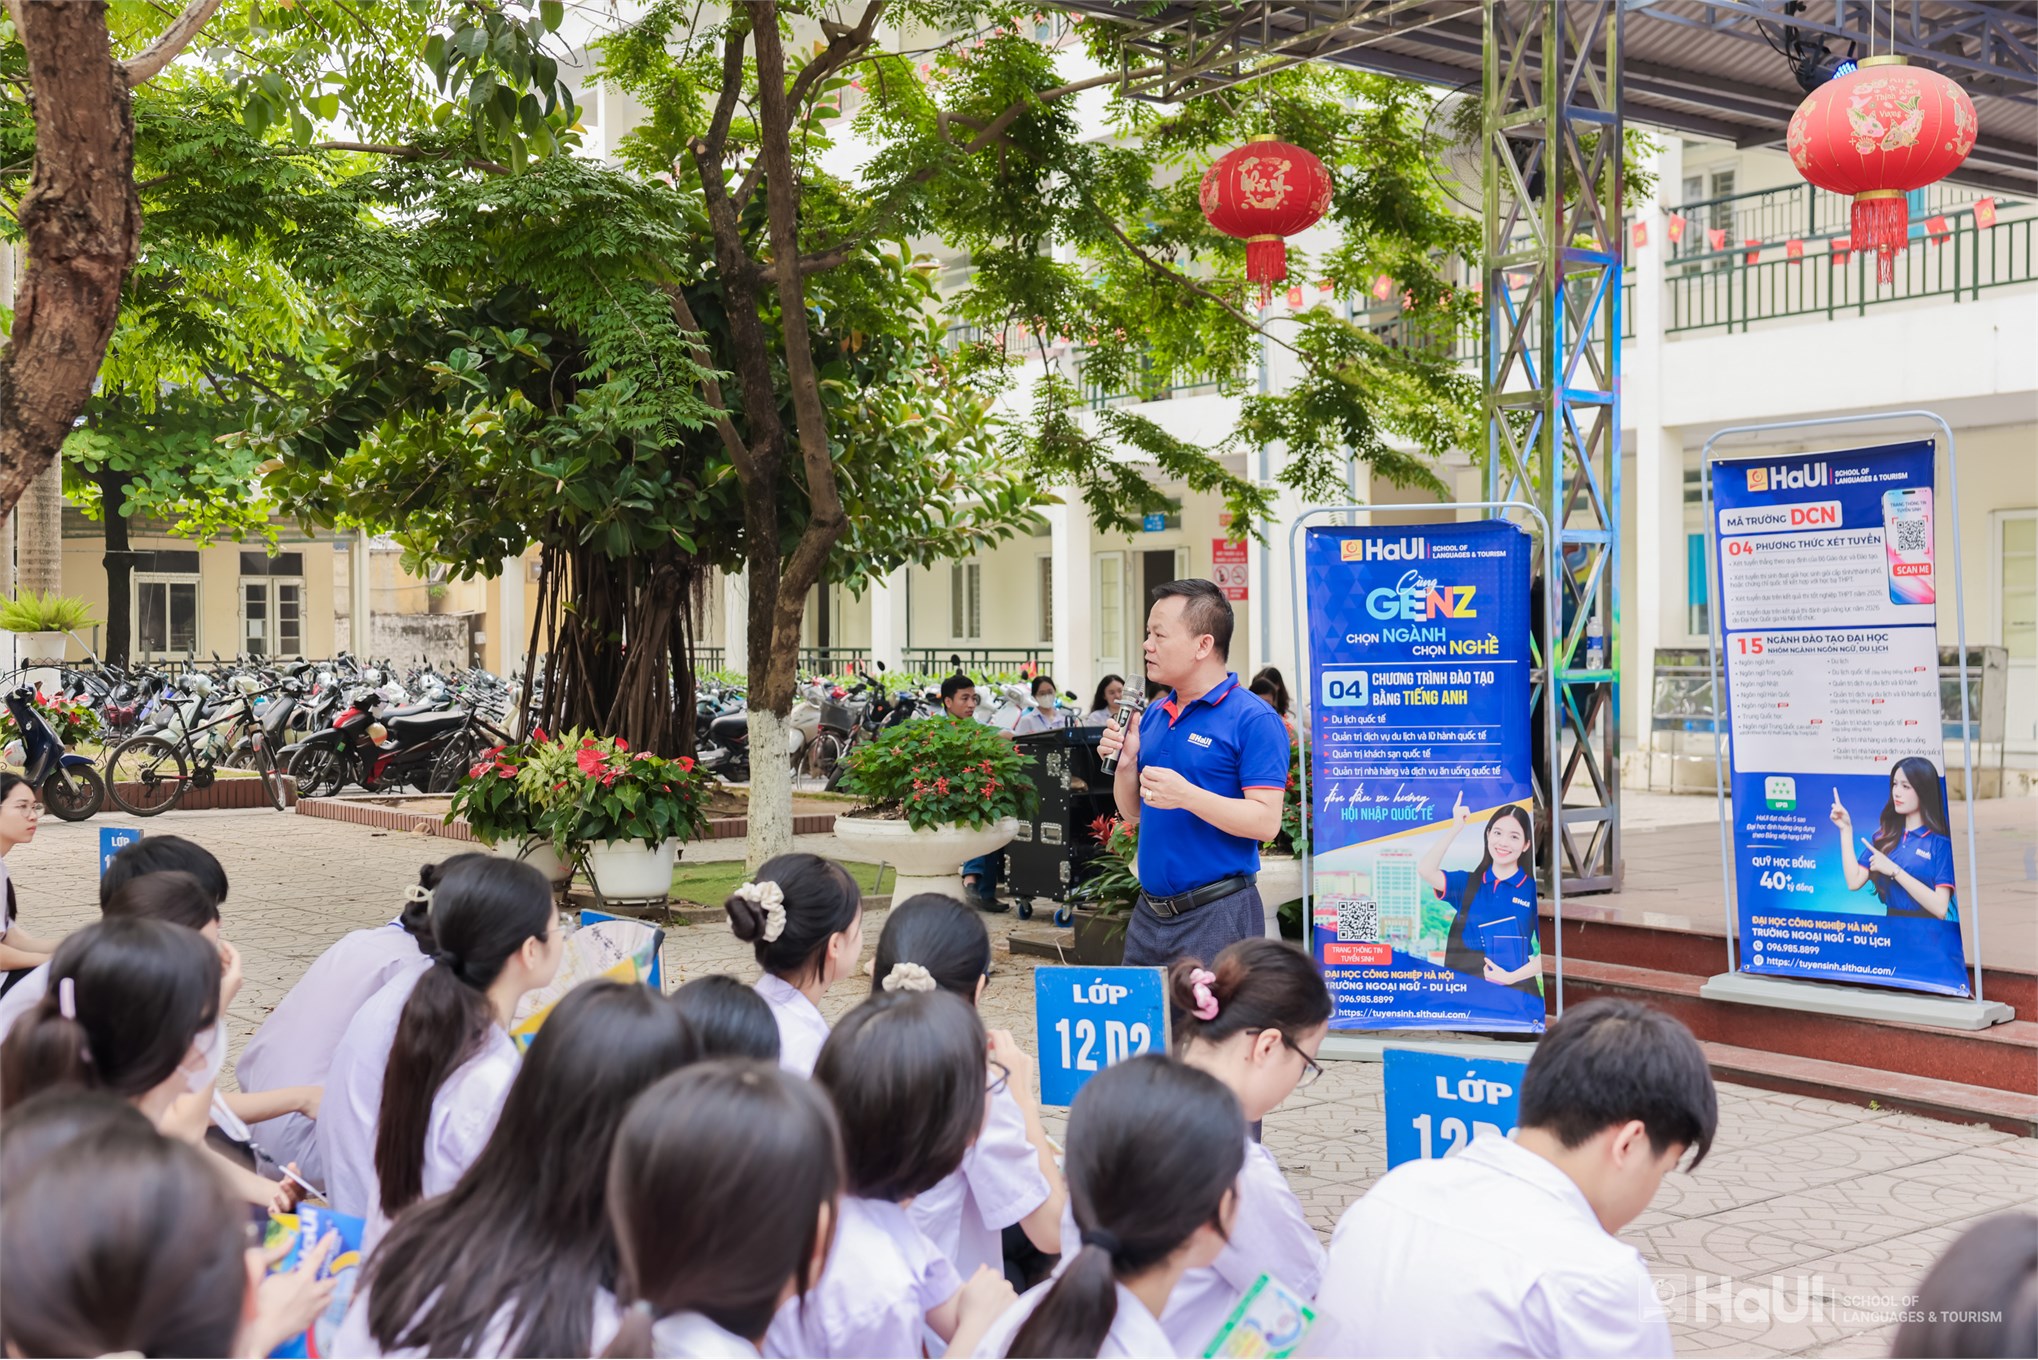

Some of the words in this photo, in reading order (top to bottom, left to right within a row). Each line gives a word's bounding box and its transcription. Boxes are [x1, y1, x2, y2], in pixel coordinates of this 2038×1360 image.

[1770, 462, 1827, 490] HaUI
[1835, 469, 1860, 477] SCHOOL
[1835, 476, 1872, 485] LANGUAGES
[1879, 472, 1907, 480] TOURISM
[1728, 516, 1742, 526] MÃ
[1745, 515, 1787, 525] TRƯỜNG
[1791, 506, 1836, 525] DCN
[1365, 538, 1424, 560] HaUI
[1729, 541, 1753, 556] 04
[1756, 540, 1796, 550] PHƯƠNG
[1800, 537, 1824, 548] THỨC
[1827, 537, 1845, 546] XÉT
[1849, 533, 1881, 546] TUYỂN
[1897, 565, 1918, 574] SCAN
[1919, 565, 1929, 573] ME
[1396, 570, 1444, 596] Cùng
[1346, 634, 1379, 646] CHỌN
[1383, 624, 1446, 643] NGÀNH
[1413, 645, 1446, 656] CHỌN
[1450, 632, 1499, 654] NGHỀ
[1738, 638, 1763, 654] 15
[1767, 636, 1800, 644] NGÀNH
[1802, 634, 1823, 643] ĐÀO
[1826, 635, 1844, 645] TẠO
[1847, 635, 1864, 644] ĐẠI
[1867, 634, 1889, 644] HỌC
[1816, 645, 1838, 654] NGÔN
[1872, 645, 1889, 654] LỊCH
[1372, 672, 1413, 685] CHƯƠNG
[1416, 668, 1447, 685] TRÌNH
[1450, 669, 1471, 684] ĐÀO
[1473, 671, 1494, 687] TẠO
[1329, 681, 1362, 699] 04
[1373, 690, 1400, 706] BẰNG
[1403, 687, 1438, 705] TIẾNG
[1441, 690, 1468, 705] ANH
[1343, 715, 1356, 724] lịch
[1358, 714, 1376, 725] quốc
[1378, 714, 1386, 723] tế
[1332, 732, 1352, 741] Quản
[1354, 732, 1362, 742] trị
[1364, 732, 1378, 741] dịch
[1381, 733, 1389, 741] vụ
[1392, 732, 1401, 740] du
[1403, 731, 1416, 741] lịch
[1417, 732, 1427, 740] và
[1428, 731, 1435, 740] lữ
[1437, 731, 1455, 740] hành
[1457, 731, 1476, 741] quốc
[1478, 731, 1486, 740] tế
[1332, 750, 1352, 759] Quản
[1354, 750, 1362, 759] trị
[1364, 749, 1385, 758] khách
[1388, 751, 1400, 759] sạn
[1402, 748, 1421, 759] quốc
[1423, 748, 1431, 757] tế
[1333, 767, 1352, 776] Quản
[1354, 767, 1362, 776] trị
[1364, 766, 1378, 775] nhà
[1380, 766, 1399, 777] hàng
[1400, 767, 1409, 775] và
[1411, 766, 1426, 776] dịch
[1428, 767, 1437, 776] vụ
[1440, 766, 1448, 775] ăn
[1451, 766, 1470, 777] uống
[1472, 766, 1490, 776] quốc
[1492, 765, 1500, 775] tế
[1376, 794, 1389, 803] xu
[1341, 807, 1358, 823] HỘI
[1361, 805, 1388, 823] NHẬP
[1391, 804, 1418, 821] QUỐC
[1420, 804, 1435, 820] TẾ
[1773, 858, 1790, 869] HỌC
[1792, 855, 1816, 869] BỔNG
[1752, 917, 1767, 925] ĐẠI
[1769, 917, 1787, 928] HỌC
[1788, 917, 1814, 928] CÔNG
[1815, 920, 1845, 931] NGHIỆP
[1847, 920, 1860, 931] HÀ
[1862, 922, 1877, 934] NỘI
[1752, 927, 1789, 938] TRƯỜNG
[1792, 930, 1821, 942] NGOẠI
[1824, 931, 1844, 943] NGỮ
[1854, 936, 1866, 945] DU
[1869, 937, 1891, 948] LỊCH
[1353, 945, 1372, 954] THÔNG
[1766, 943, 1819, 955] 096.985.8899
[1325, 970, 1339, 980] ĐẠI
[1341, 970, 1361, 980] HỌC
[1363, 969, 1389, 979] CÔNG
[1391, 970, 1423, 980] NGHIỆP
[1424, 969, 1436, 980] HÀ
[1438, 970, 1454, 982] NỘI
[1072, 978, 1128, 1005] LỚP
[1326, 980, 1363, 990] TRƯỜNG
[1365, 982, 1397, 992] NGOẠI
[1400, 980, 1421, 991] NGỮ
[1430, 984, 1443, 992] DU
[1445, 984, 1467, 994] LỊCH
[1339, 995, 1394, 1004] 096.985.8899
[1055, 1018, 1098, 1072] 12
[1436, 1070, 1513, 1105] LỚP
